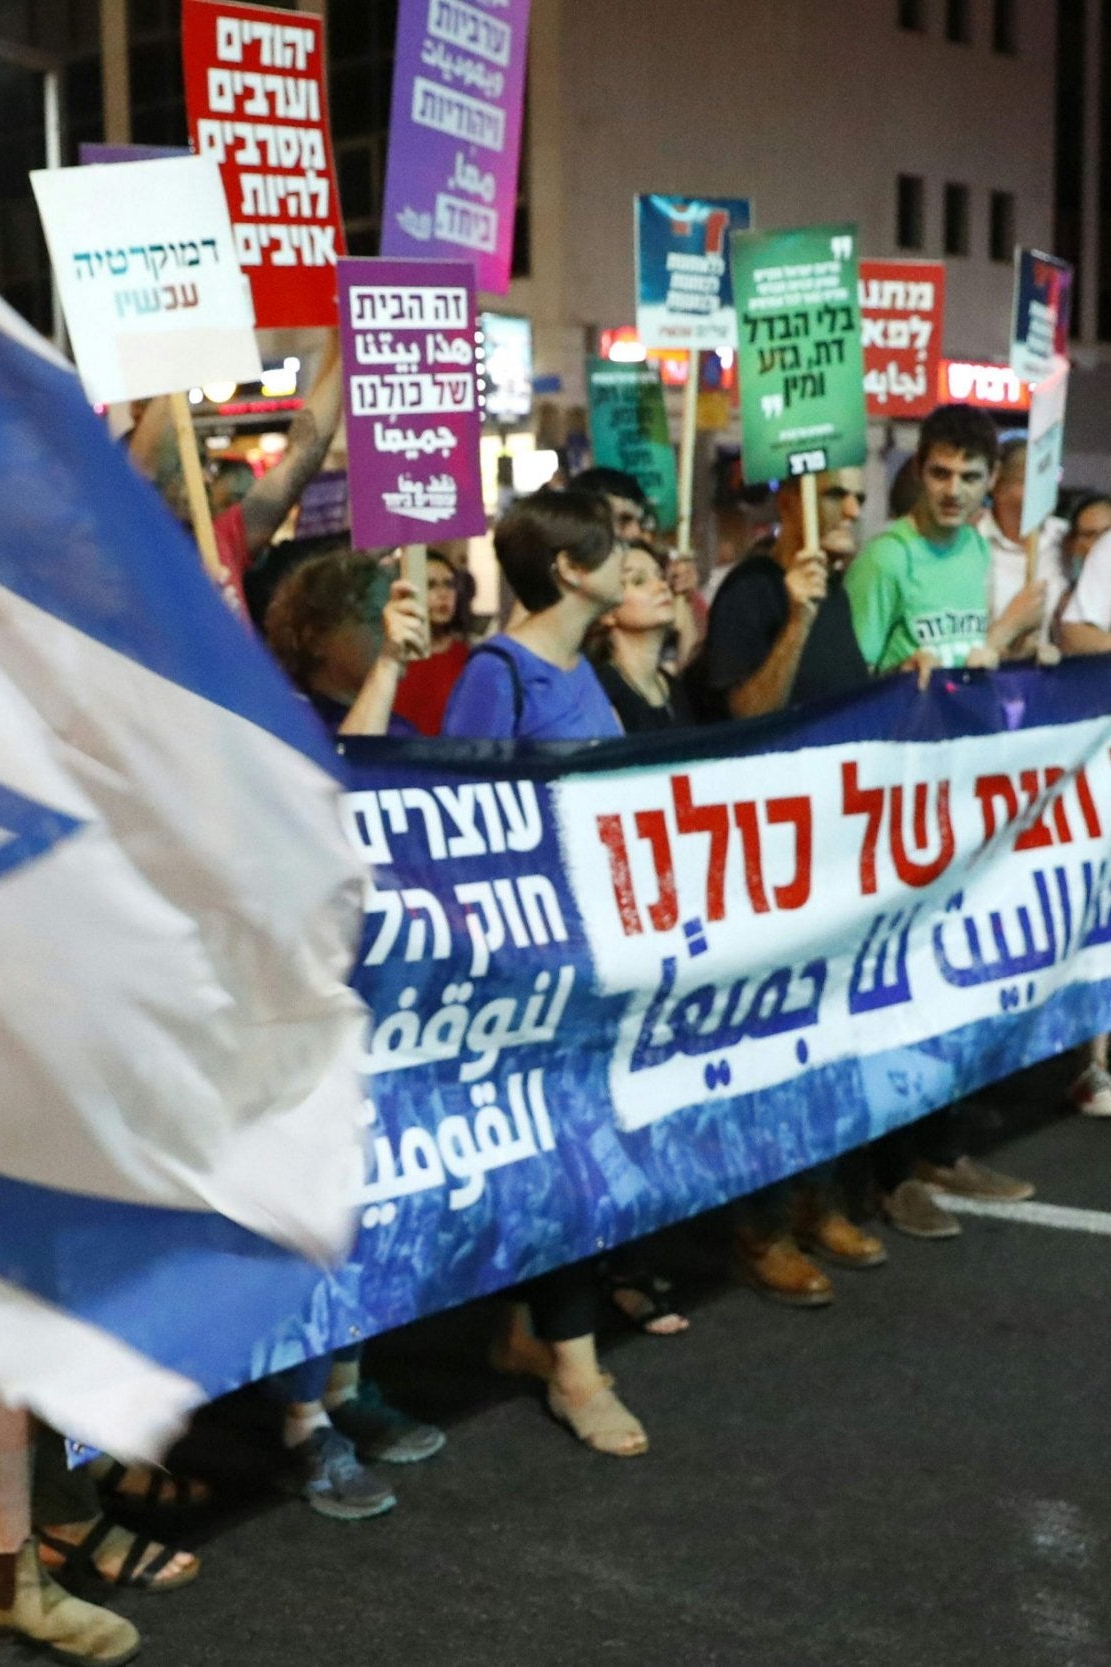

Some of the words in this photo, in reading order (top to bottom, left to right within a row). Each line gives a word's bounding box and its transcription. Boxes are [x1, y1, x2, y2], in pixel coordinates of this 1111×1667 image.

[216, 16, 316, 71] יהודים
[207, 67, 321, 122] וערבים
[197, 118, 326, 170] מסרבים
[239, 168, 330, 219] להיות
[73, 238, 220, 281] דמוקרטיה
[232, 222, 339, 267] אויבים
[115, 283, 200, 318] עכשיו
[356, 293, 424, 321] הבית
[434, 294, 462, 320] זה
[818, 304, 856, 333] בלי
[744, 311, 808, 344] הבדל
[354, 331, 422, 374] بيتنا
[425, 333, 473, 366] هذا
[758, 345, 801, 374] גזע
[357, 374, 423, 409] כולנו
[432, 374, 467, 406] של
[783, 373, 826, 407] ומין
[345, 780, 543, 864] עוצרים
[841, 762, 955, 895] של
[596, 775, 813, 936] כולנו
[364, 889, 452, 967] הל
[456, 875, 568, 977] חוק
[352, 1068, 556, 1230] القومي
